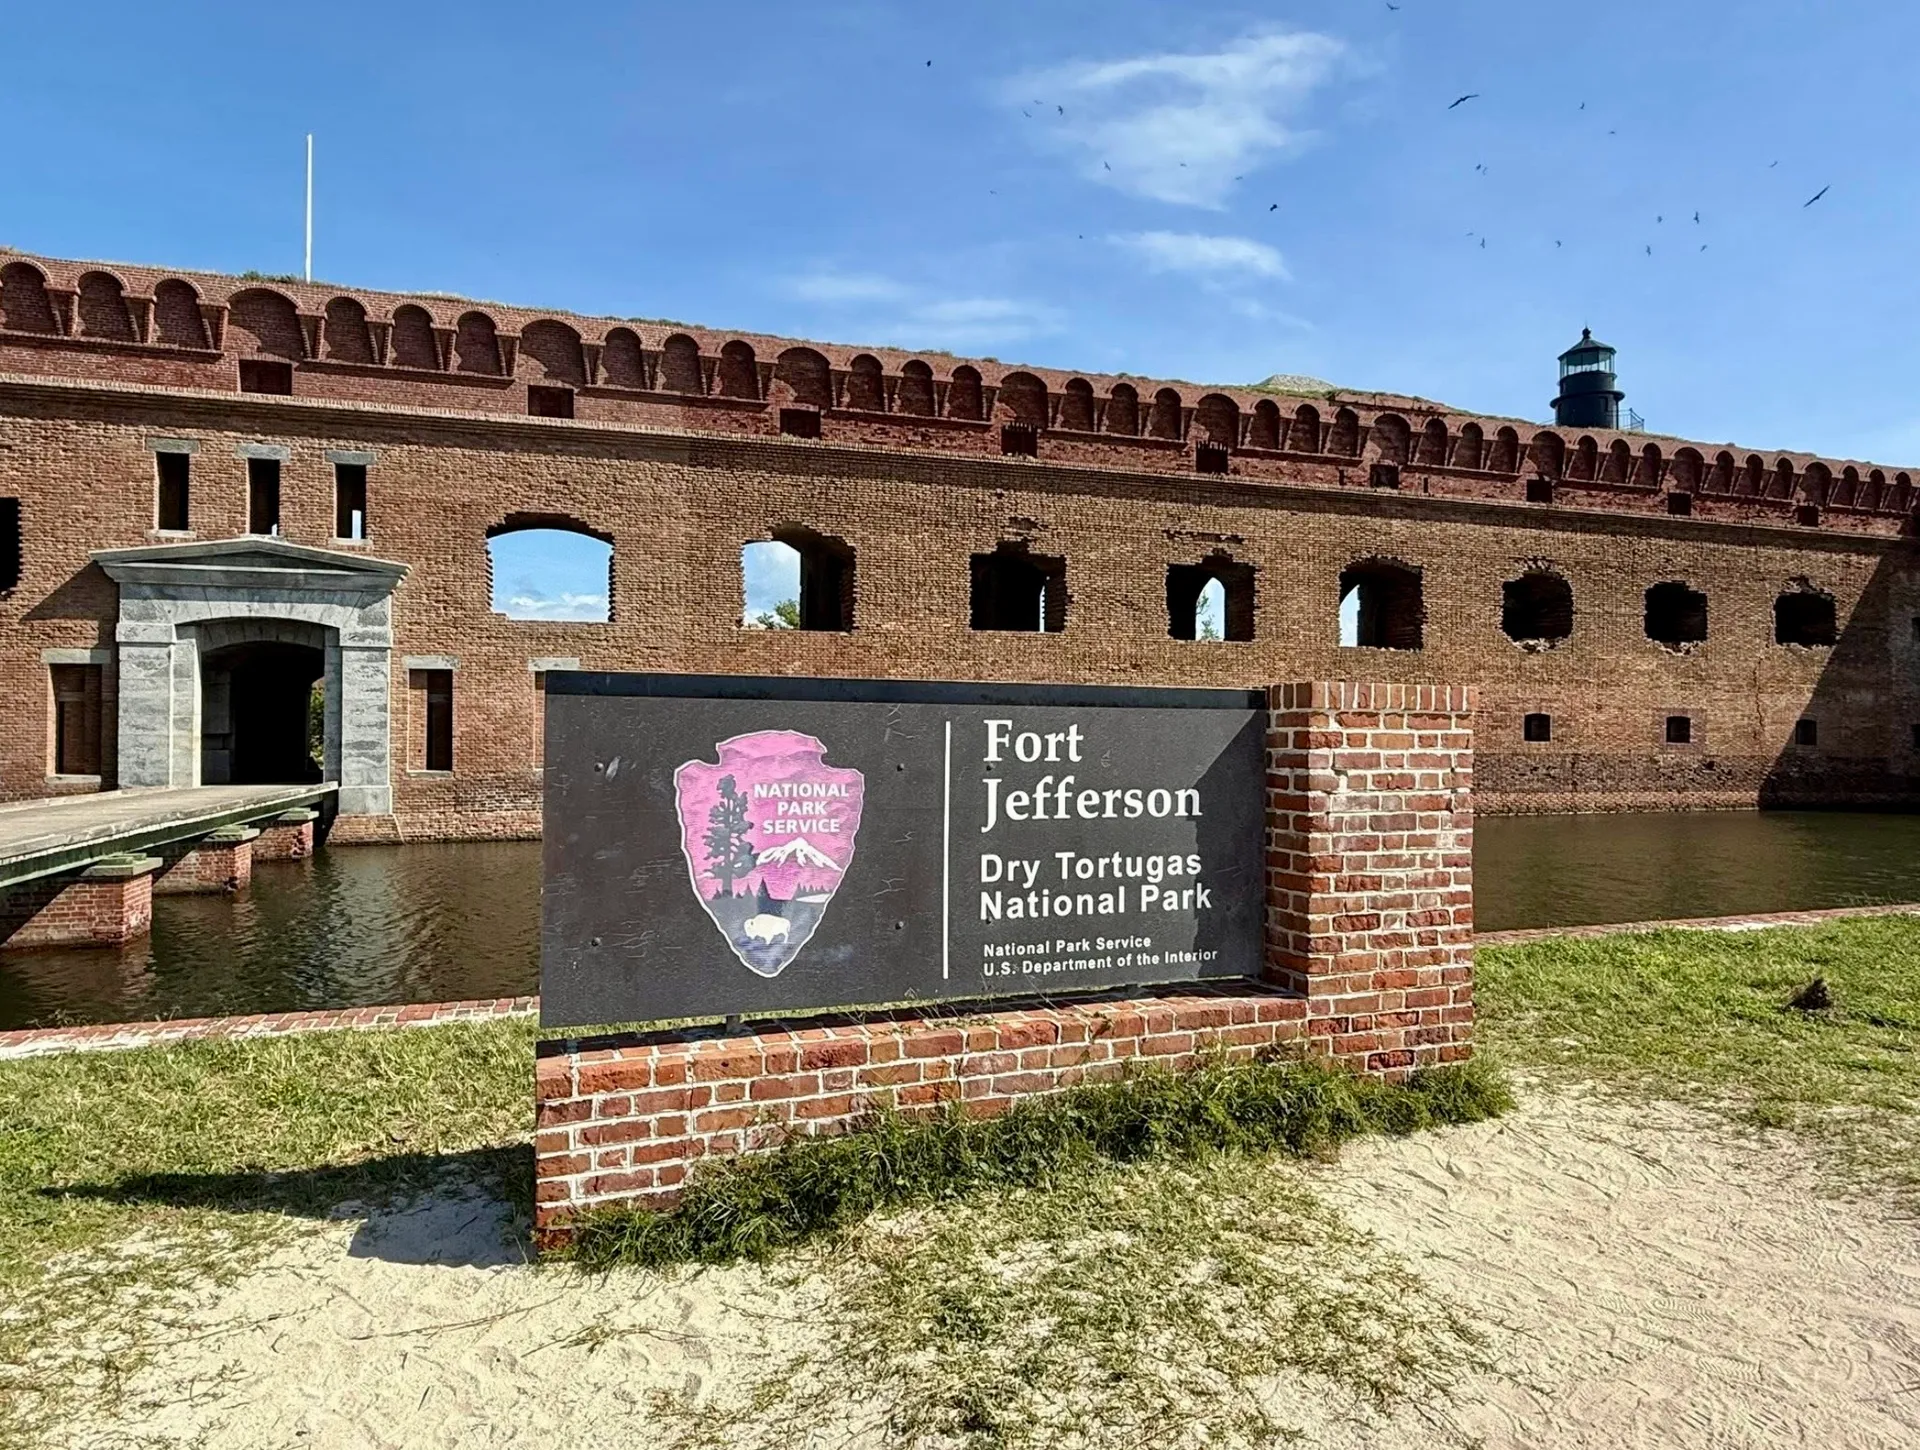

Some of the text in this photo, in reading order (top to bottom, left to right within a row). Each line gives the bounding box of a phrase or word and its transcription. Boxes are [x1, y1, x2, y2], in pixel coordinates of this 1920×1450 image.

[983, 719, 1084, 763] Fort
[753, 783, 849, 799] NATIONAL
[981, 775, 1203, 833] Jefferson
[777, 801, 827, 816] PARK
[763, 818, 840, 834] SERVICE
[980, 851, 1202, 889] Dry Tortugas
[980, 883, 1212, 920] National Park
[983, 935, 1152, 957] National Park Service
[983, 949, 1218, 976] U.S. Department of the Interior
